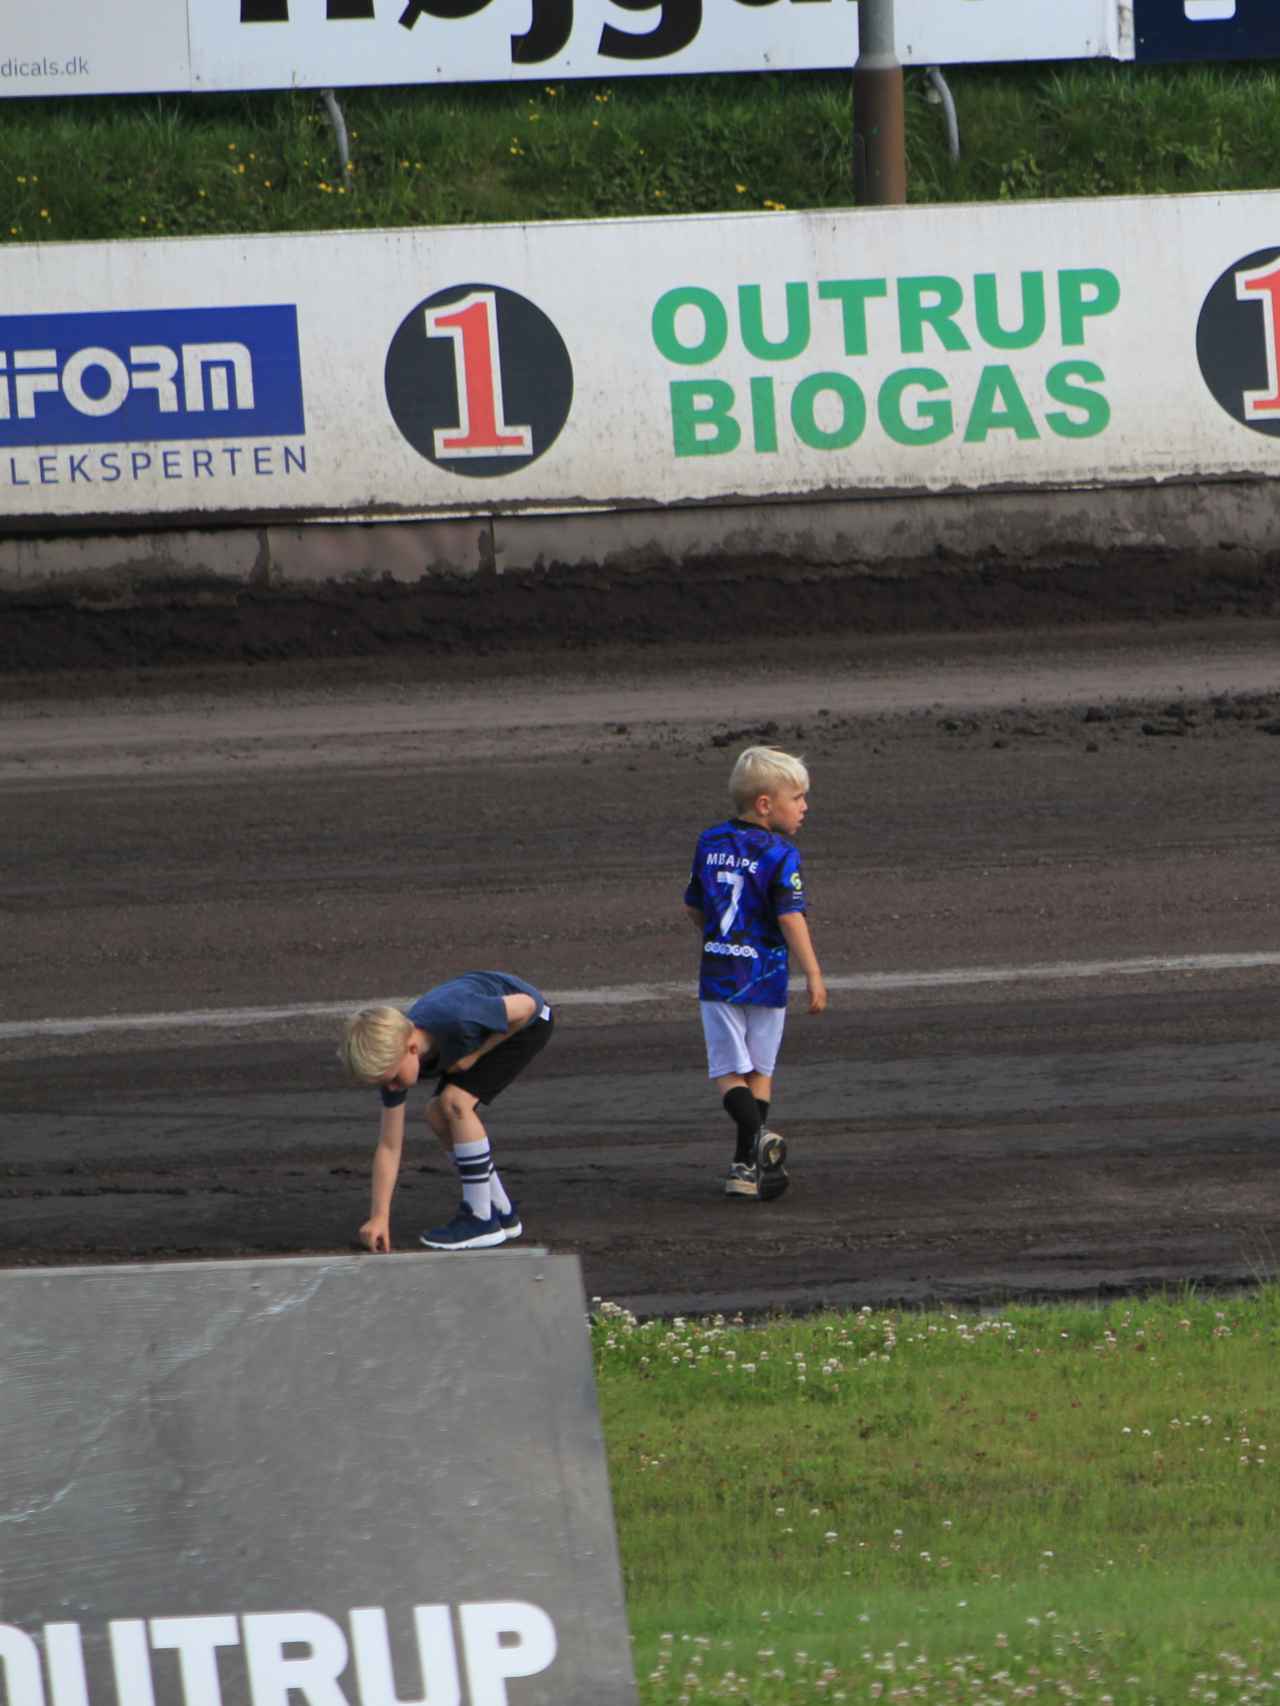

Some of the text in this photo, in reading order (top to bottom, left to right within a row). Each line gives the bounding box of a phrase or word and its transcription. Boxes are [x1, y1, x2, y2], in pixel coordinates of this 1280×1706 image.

[0, 56, 89, 78] dicals.dk
[651, 268, 1120, 366] OUTRUP
[424, 291, 533, 460] 1
[669, 360, 1111, 458] BIOGAS
[10, 445, 307, 486] LEKSPERTEN
[717, 871, 744, 937] 7
